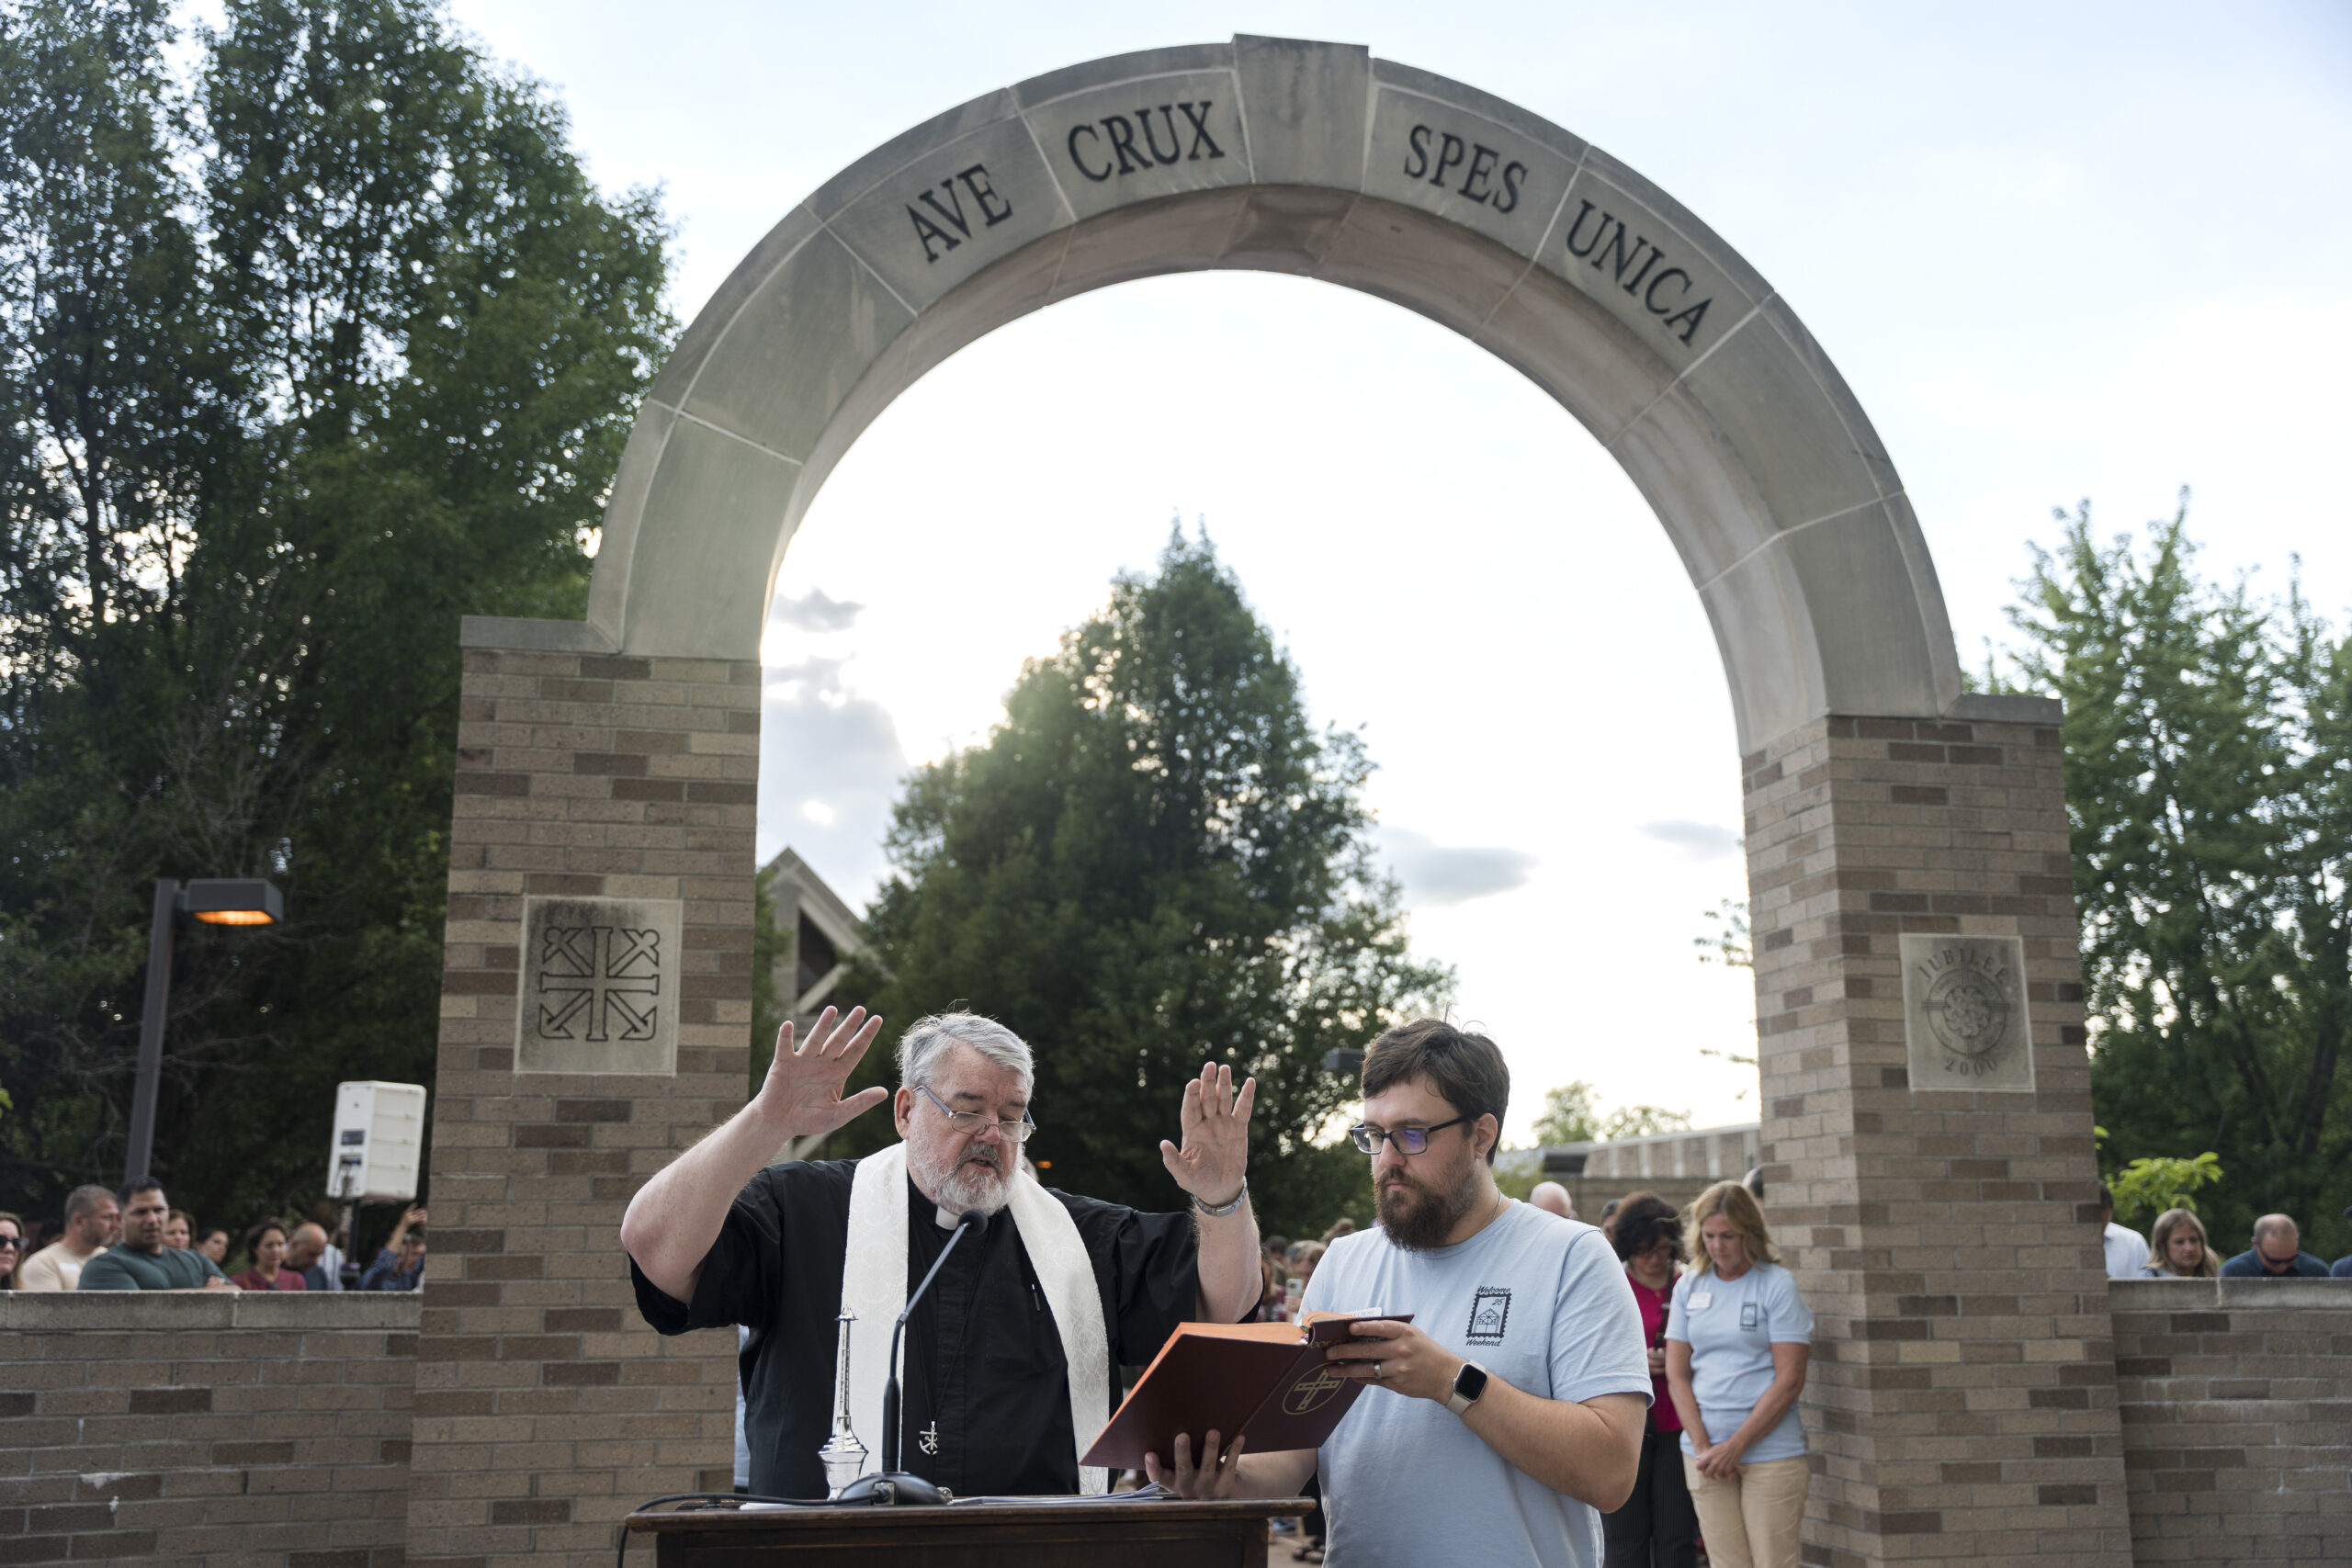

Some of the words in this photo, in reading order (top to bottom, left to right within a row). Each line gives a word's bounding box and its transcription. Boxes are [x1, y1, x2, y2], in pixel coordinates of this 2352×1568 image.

[904, 163, 1013, 264] AVE
[1067, 100, 1226, 182] CRUX
[1404, 124, 1529, 216] SPES
[1566, 198, 1715, 346] UNICA
[1944, 1057, 1998, 1076] 2000
[1476, 1285, 1511, 1293] Welcome
[1465, 1338, 1503, 1347] Weekend
